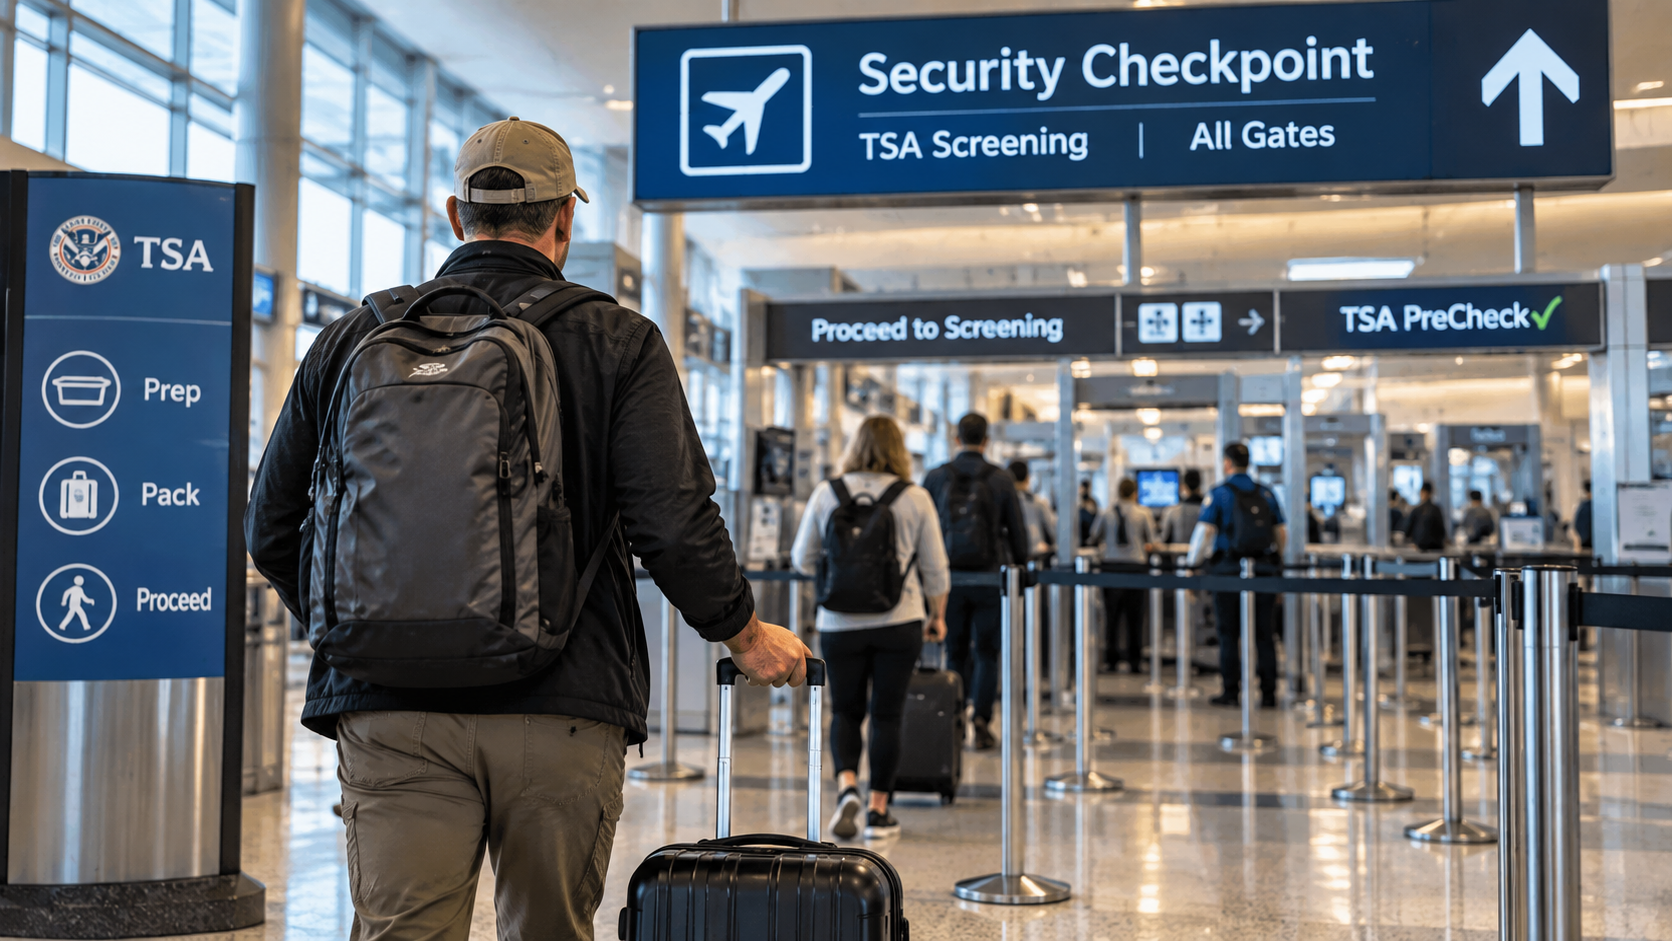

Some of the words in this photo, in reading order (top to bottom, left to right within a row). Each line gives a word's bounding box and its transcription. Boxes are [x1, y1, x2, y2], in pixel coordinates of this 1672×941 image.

[858, 47, 1065, 102] Security
[1082, 36, 1374, 95] Checkpoint
[858, 131, 923, 161] TSA
[932, 126, 1088, 162] Screening
[1189, 120, 1232, 150] All
[1241, 120, 1336, 150] Gates
[133, 235, 214, 273] TSA
[811, 316, 908, 342] Proceed
[912, 318, 939, 341] to
[944, 312, 1064, 344] Screening
[1339, 305, 1398, 333] TSA
[1403, 301, 1530, 332] PreCheck
[144, 377, 202, 408] Prep
[141, 481, 200, 507] Pack
[136, 585, 212, 612] Proceed
